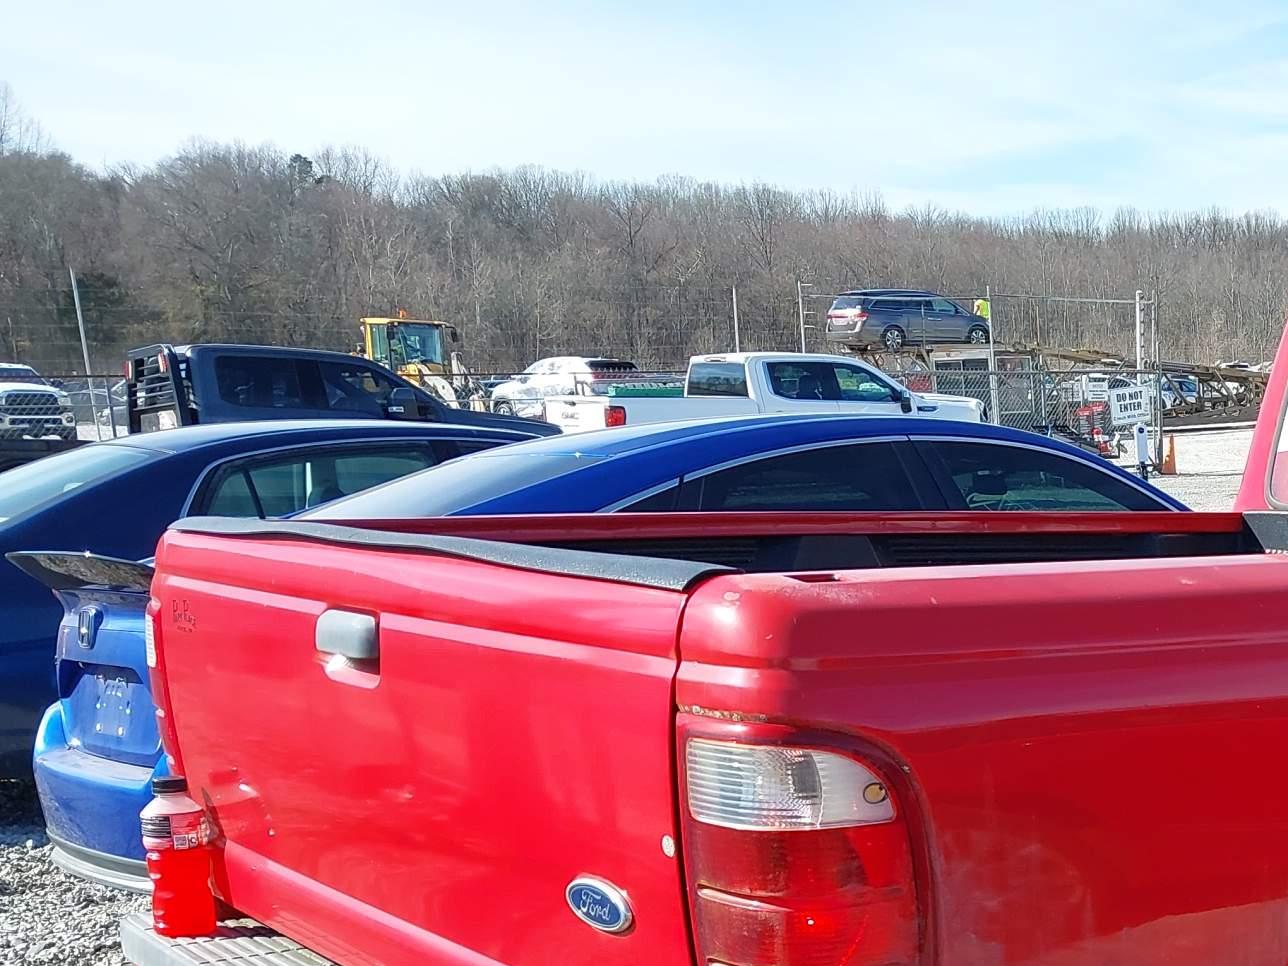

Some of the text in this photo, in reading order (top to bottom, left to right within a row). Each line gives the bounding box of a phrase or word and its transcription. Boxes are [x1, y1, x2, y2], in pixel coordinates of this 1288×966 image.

[1116, 390, 1143, 402] DO NOT
[1119, 401, 1142, 413] ENTER
[580, 889, 611, 921] Ford
